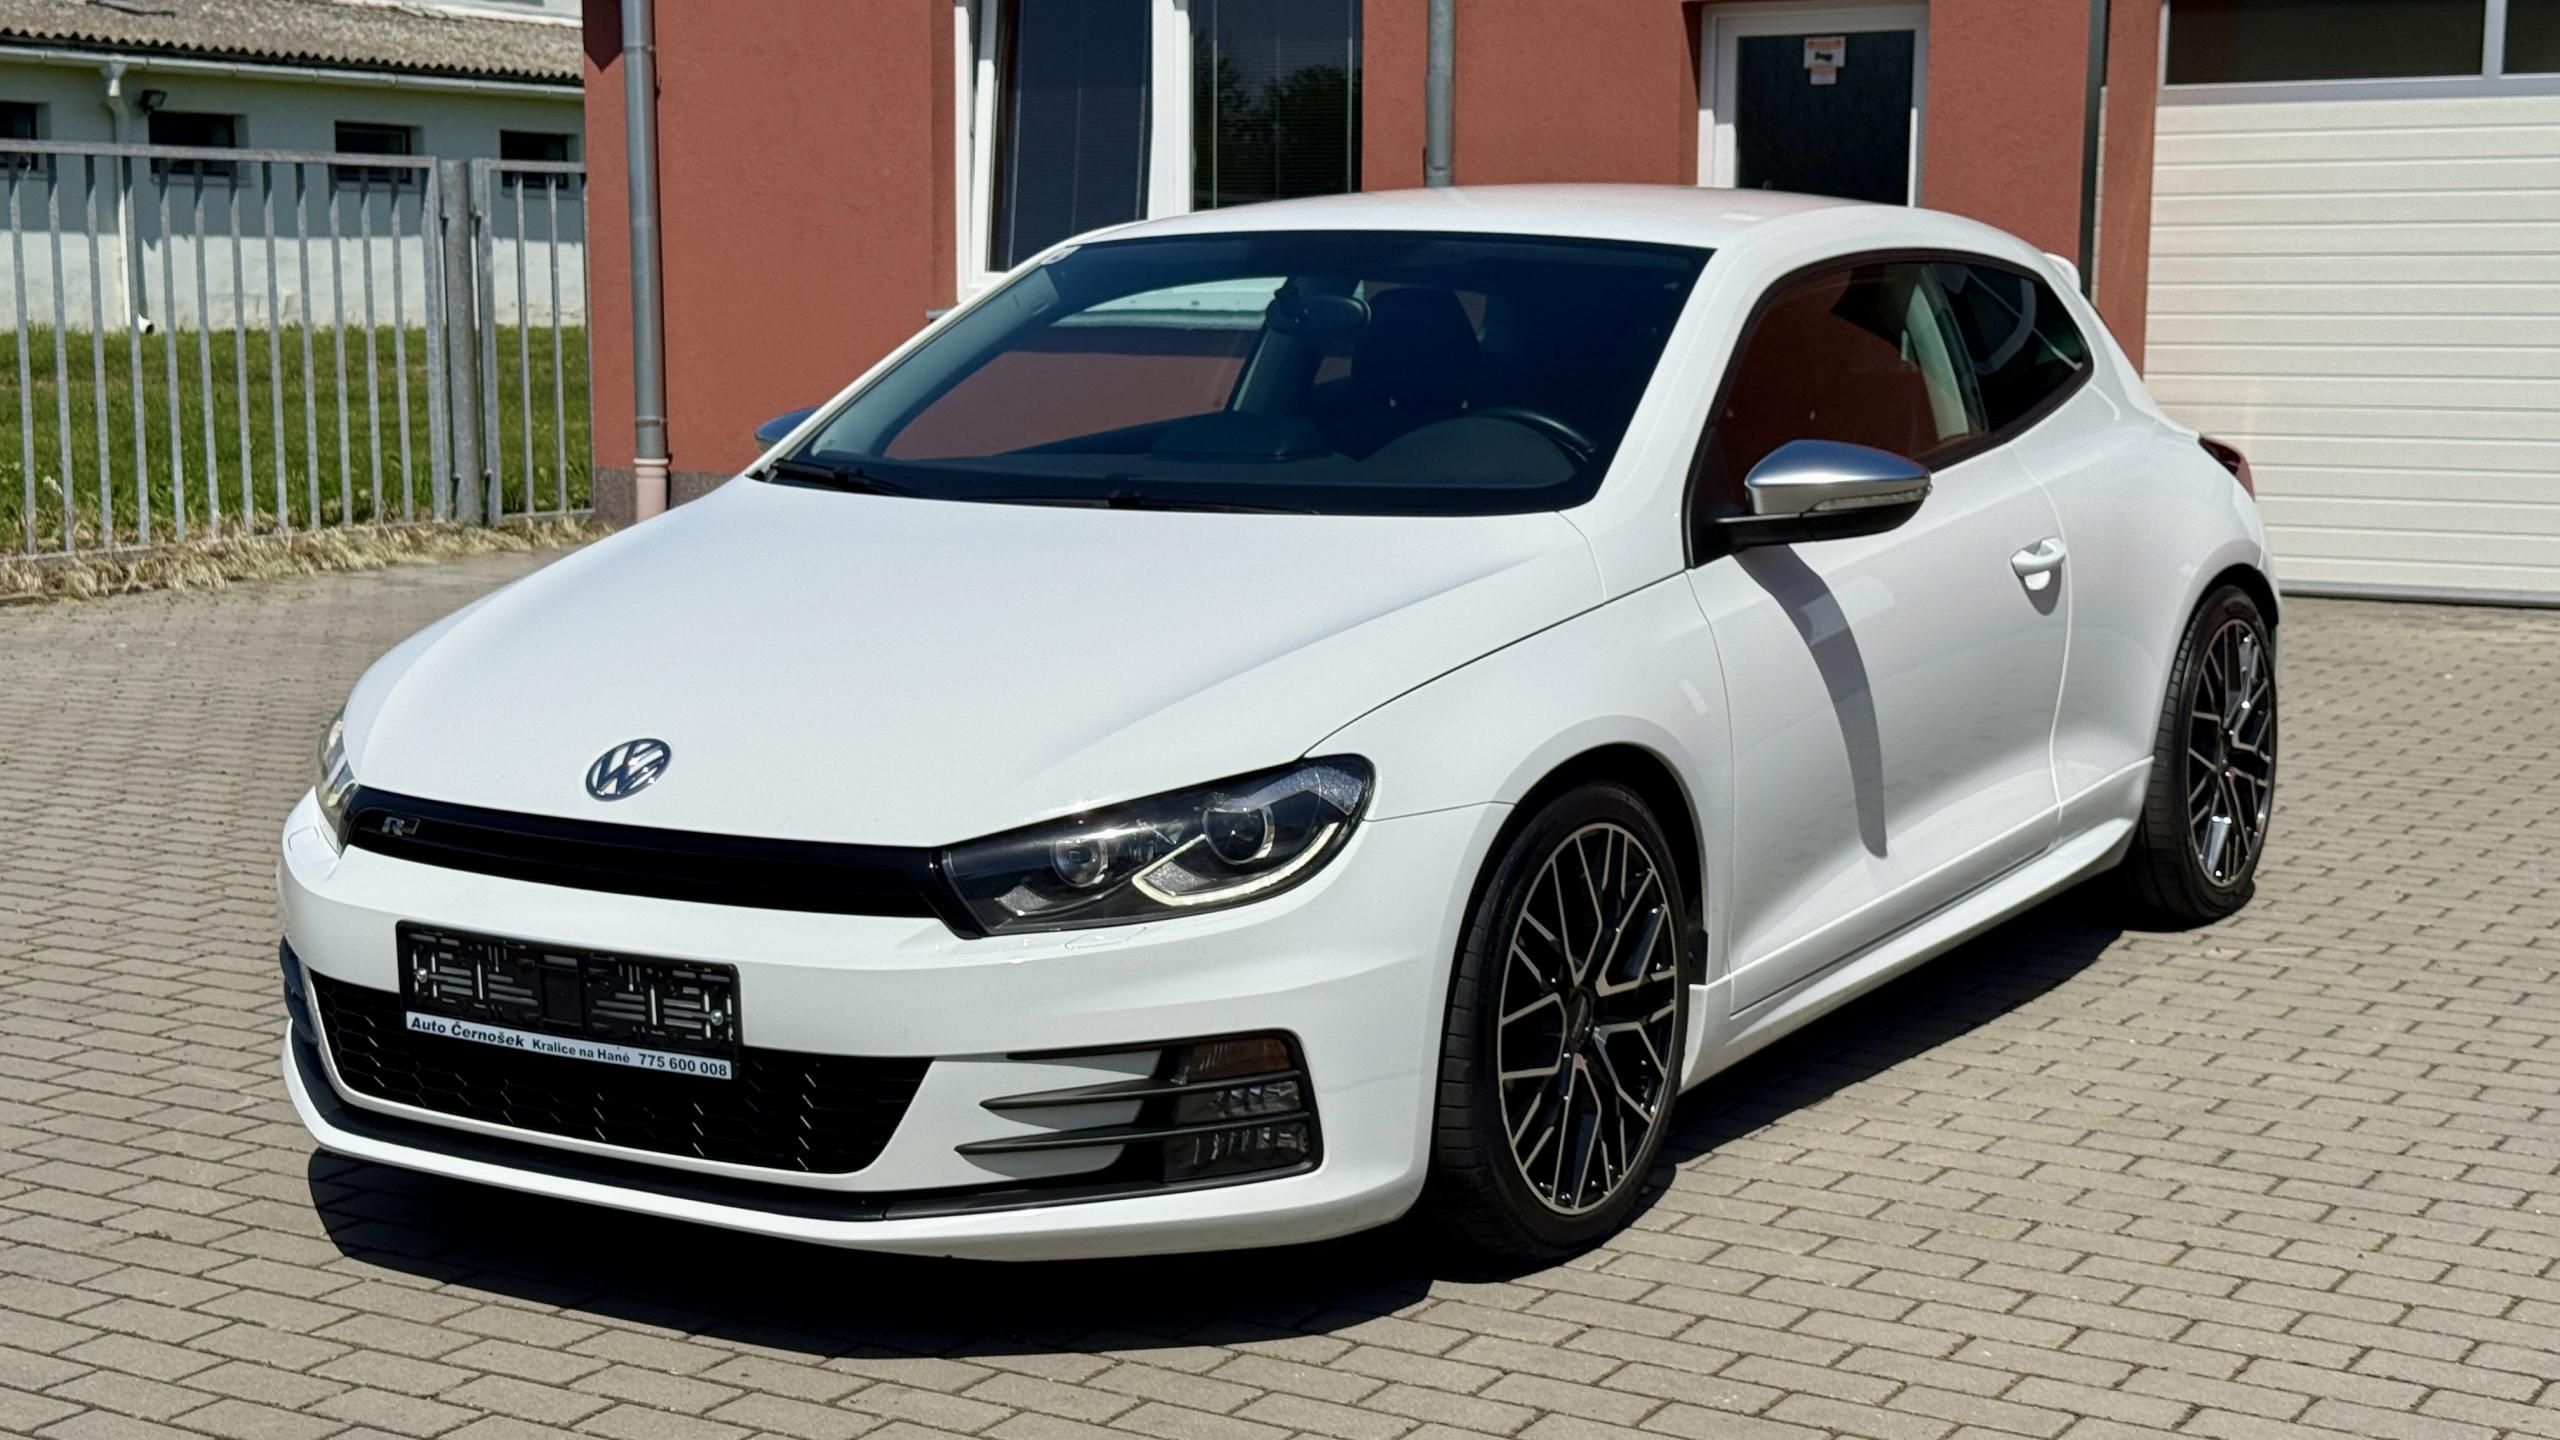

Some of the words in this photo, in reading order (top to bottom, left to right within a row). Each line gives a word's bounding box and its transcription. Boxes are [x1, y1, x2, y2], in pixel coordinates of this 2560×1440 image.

[586, 739, 670, 801] VW
[381, 816, 405, 836] R
[411, 1017, 446, 1034] Auto
[451, 1022, 524, 1048] Černošek
[532, 1039, 577, 1056] Kralice
[579, 1048, 594, 1058] na
[597, 1048, 630, 1064] Hané
[638, 1053, 665, 1069] 775
[669, 1058, 696, 1072] 600
[700, 1062, 728, 1077] 008
